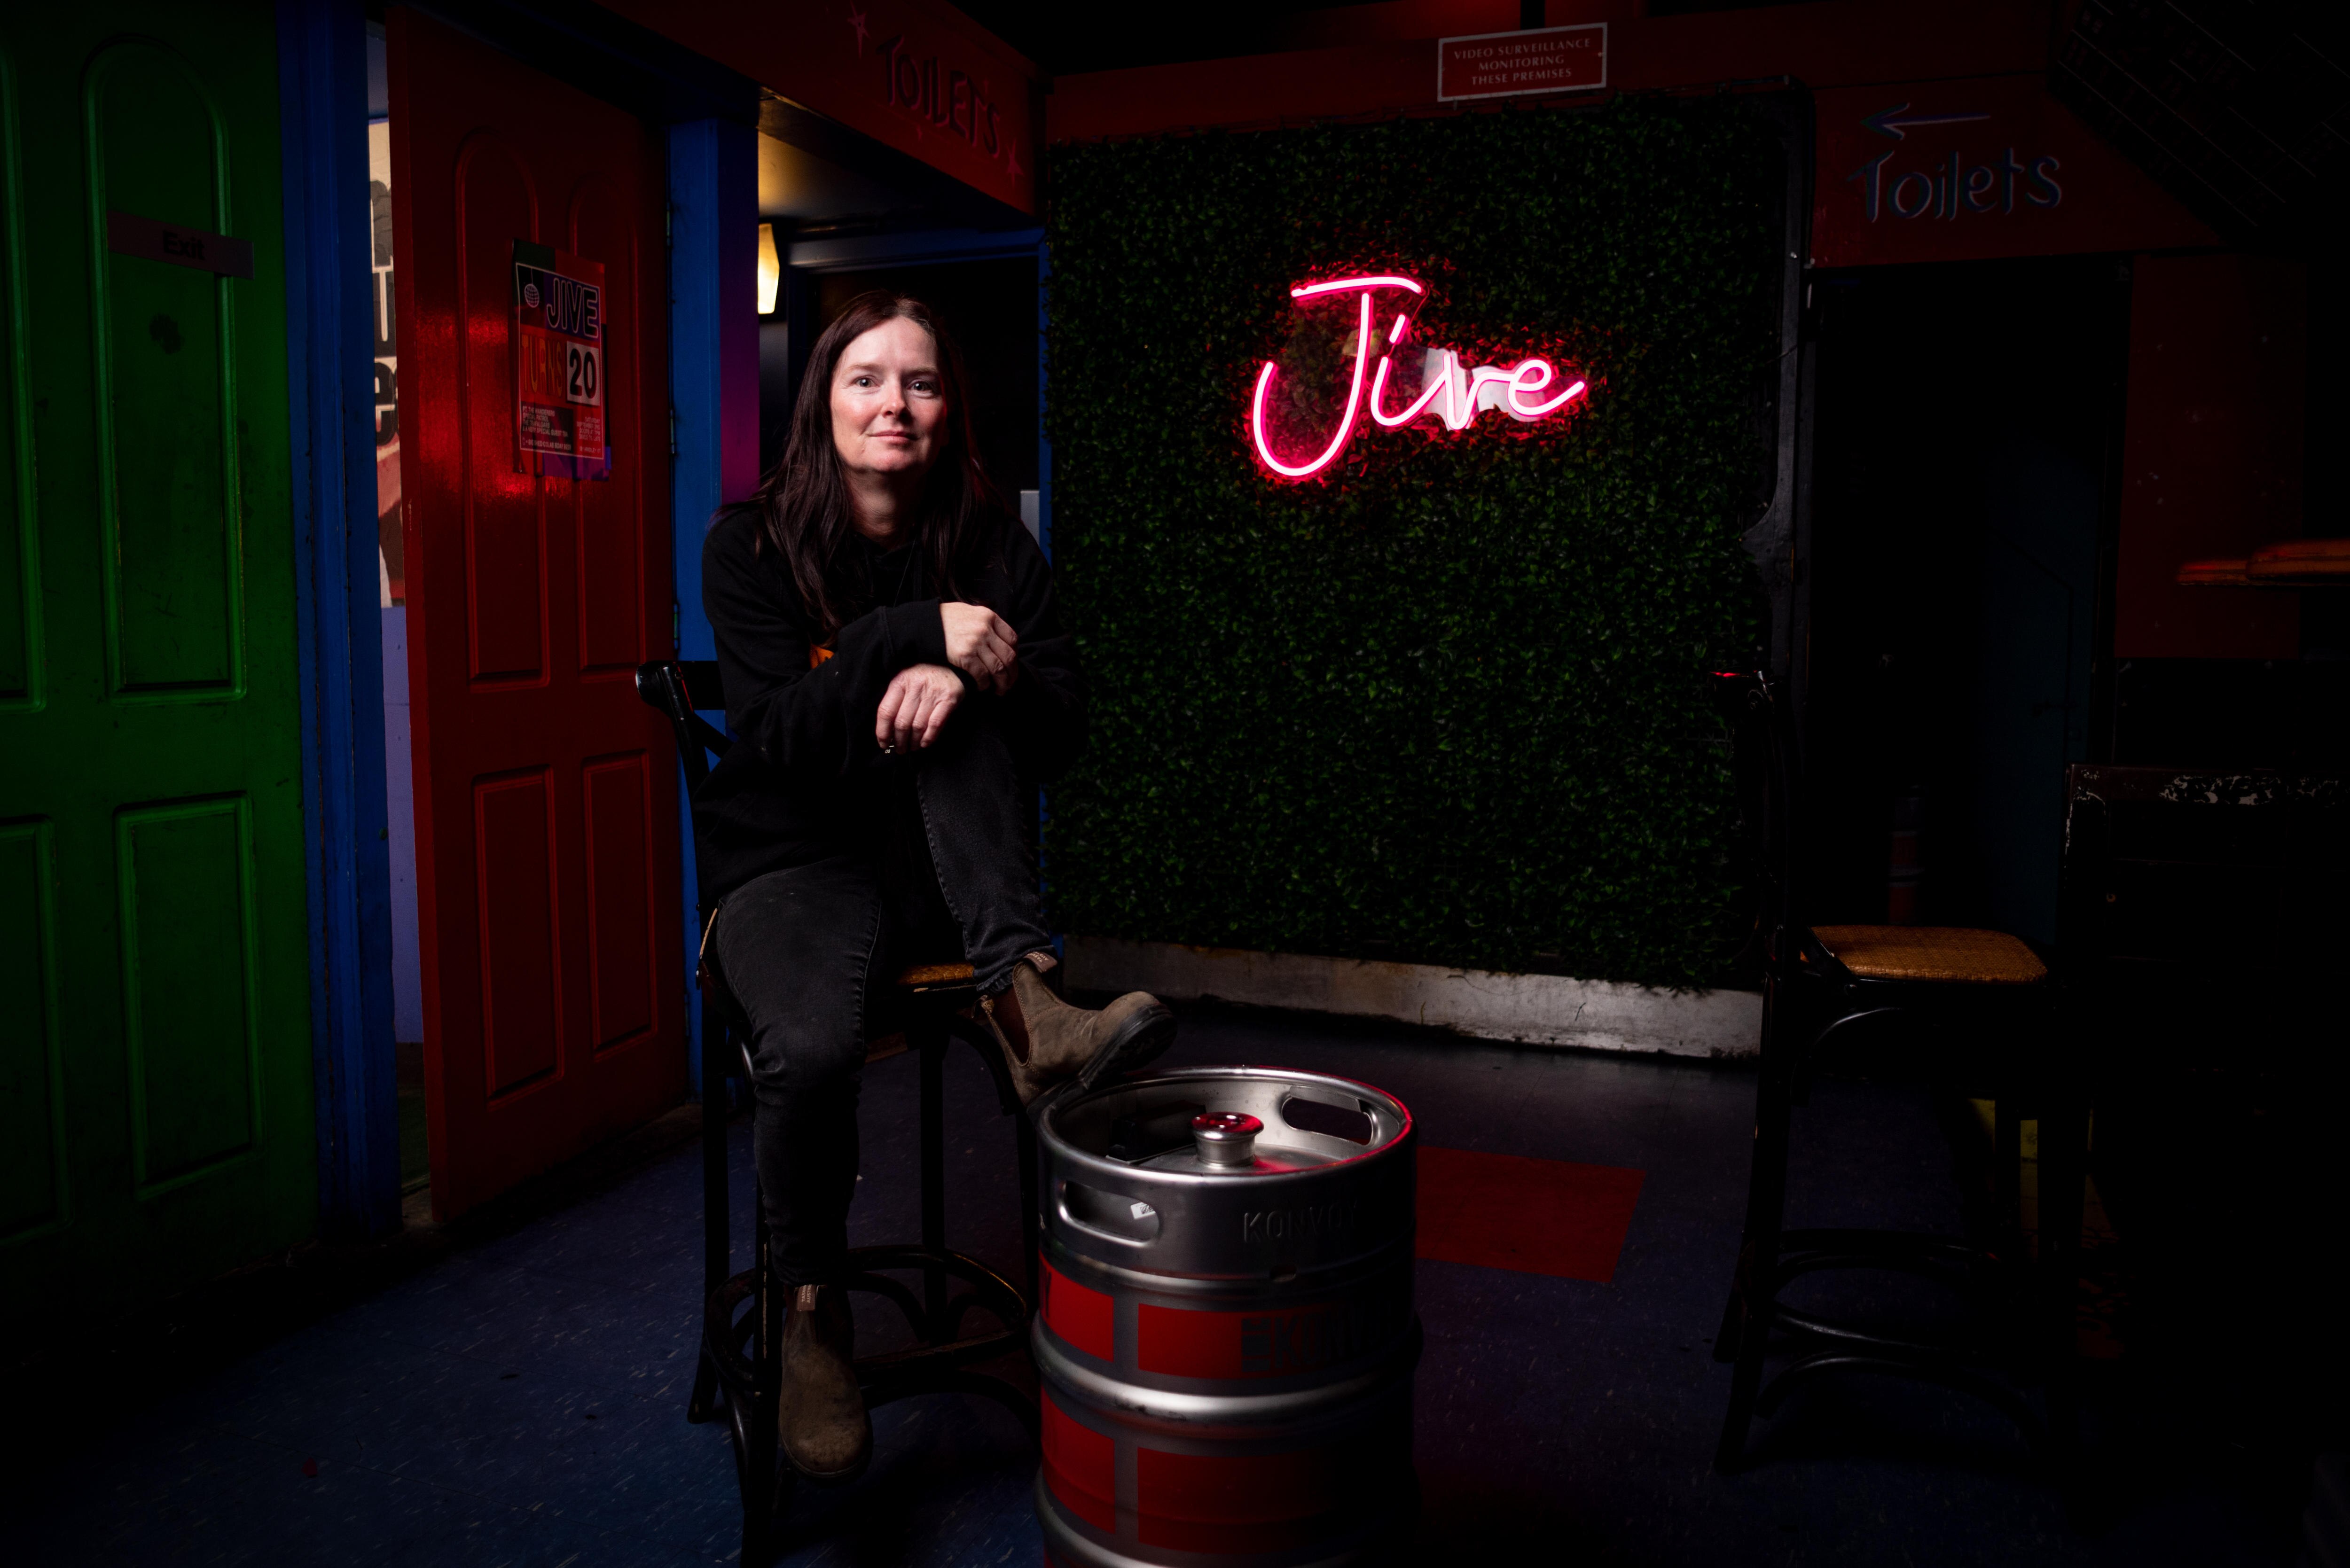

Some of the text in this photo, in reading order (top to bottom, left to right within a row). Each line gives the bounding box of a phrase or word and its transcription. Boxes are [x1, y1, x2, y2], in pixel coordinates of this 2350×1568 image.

[1453, 38, 1591, 60] VIDEO SURVEILLANCE
[1478, 54, 1565, 71] MONITORING
[1472, 68, 1572, 86] THESE PREMISES
[1846, 147, 2062, 224] Toilets
[163, 230, 205, 261] Exit
[547, 277, 600, 339] JIVE
[521, 333, 597, 399] TURNS 20
[1253, 275, 1585, 477] Jive
[1243, 1196, 1358, 1243] KONVOY
[1274, 1295, 1392, 1370] KONV
